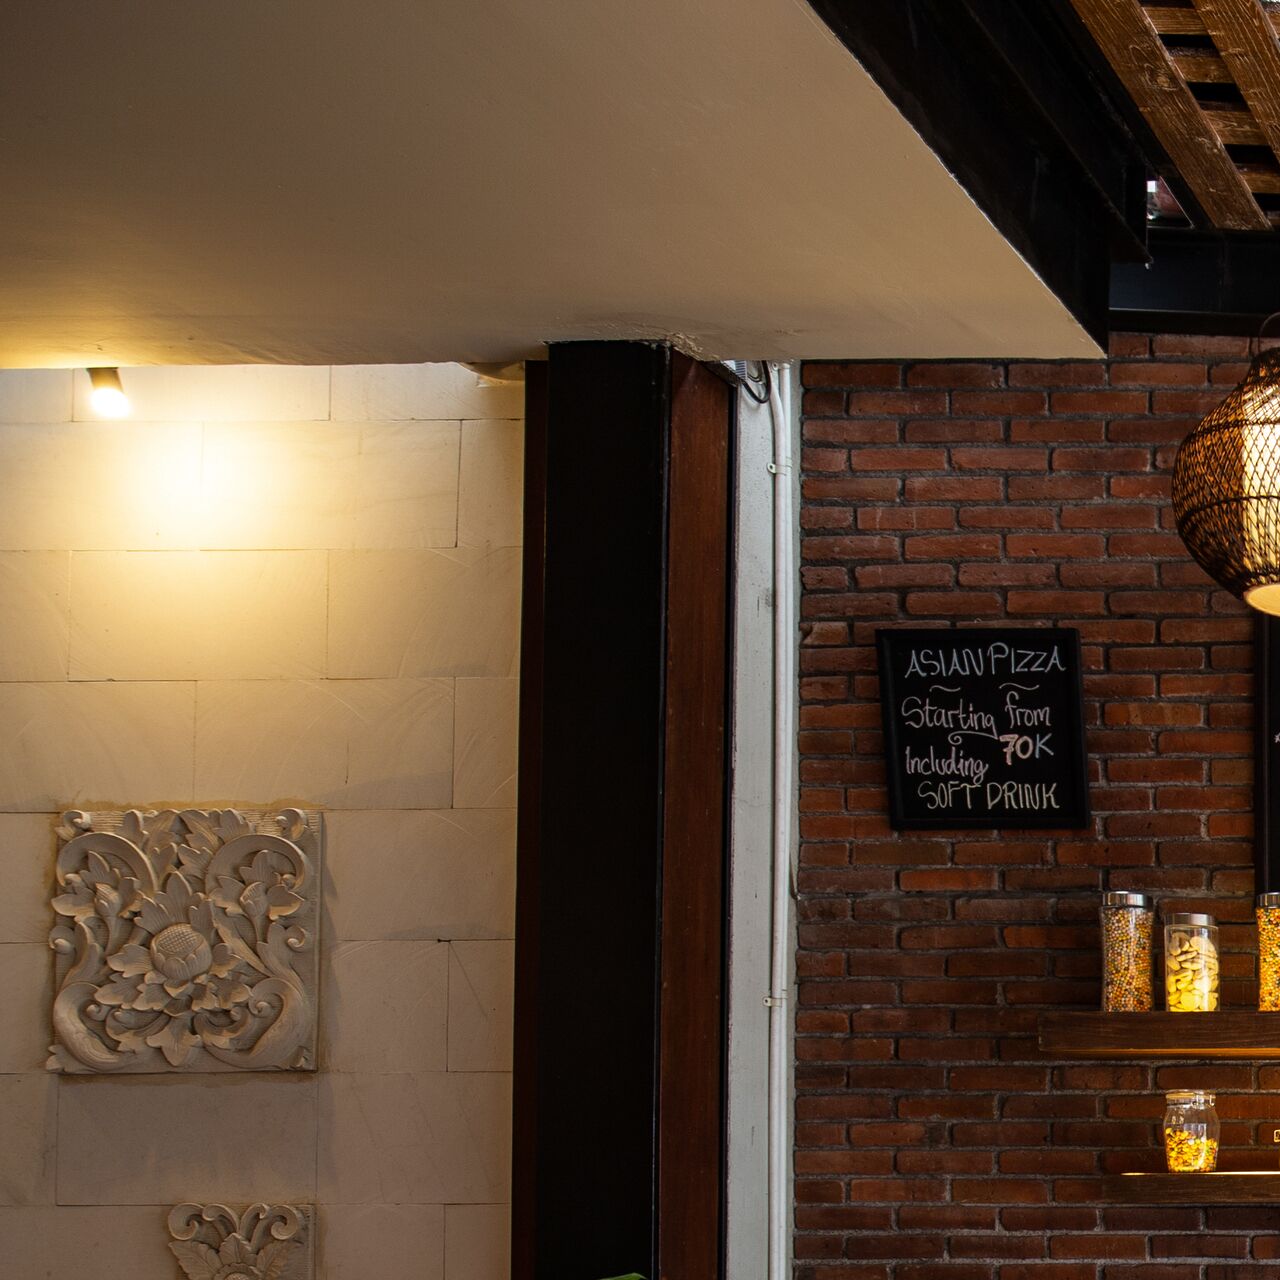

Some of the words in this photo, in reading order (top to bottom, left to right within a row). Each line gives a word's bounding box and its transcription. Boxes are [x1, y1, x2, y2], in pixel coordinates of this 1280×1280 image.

[905, 648, 984, 678] ASIAN
[988, 642, 1066, 675] PIZZA
[901, 696, 1000, 744] Starting
[1004, 691, 1051, 728] from
[905, 746, 989, 785] Including
[1000, 734, 1054, 765] 70K
[918, 781, 981, 809] SOFT
[987, 781, 1060, 809] DRINK
